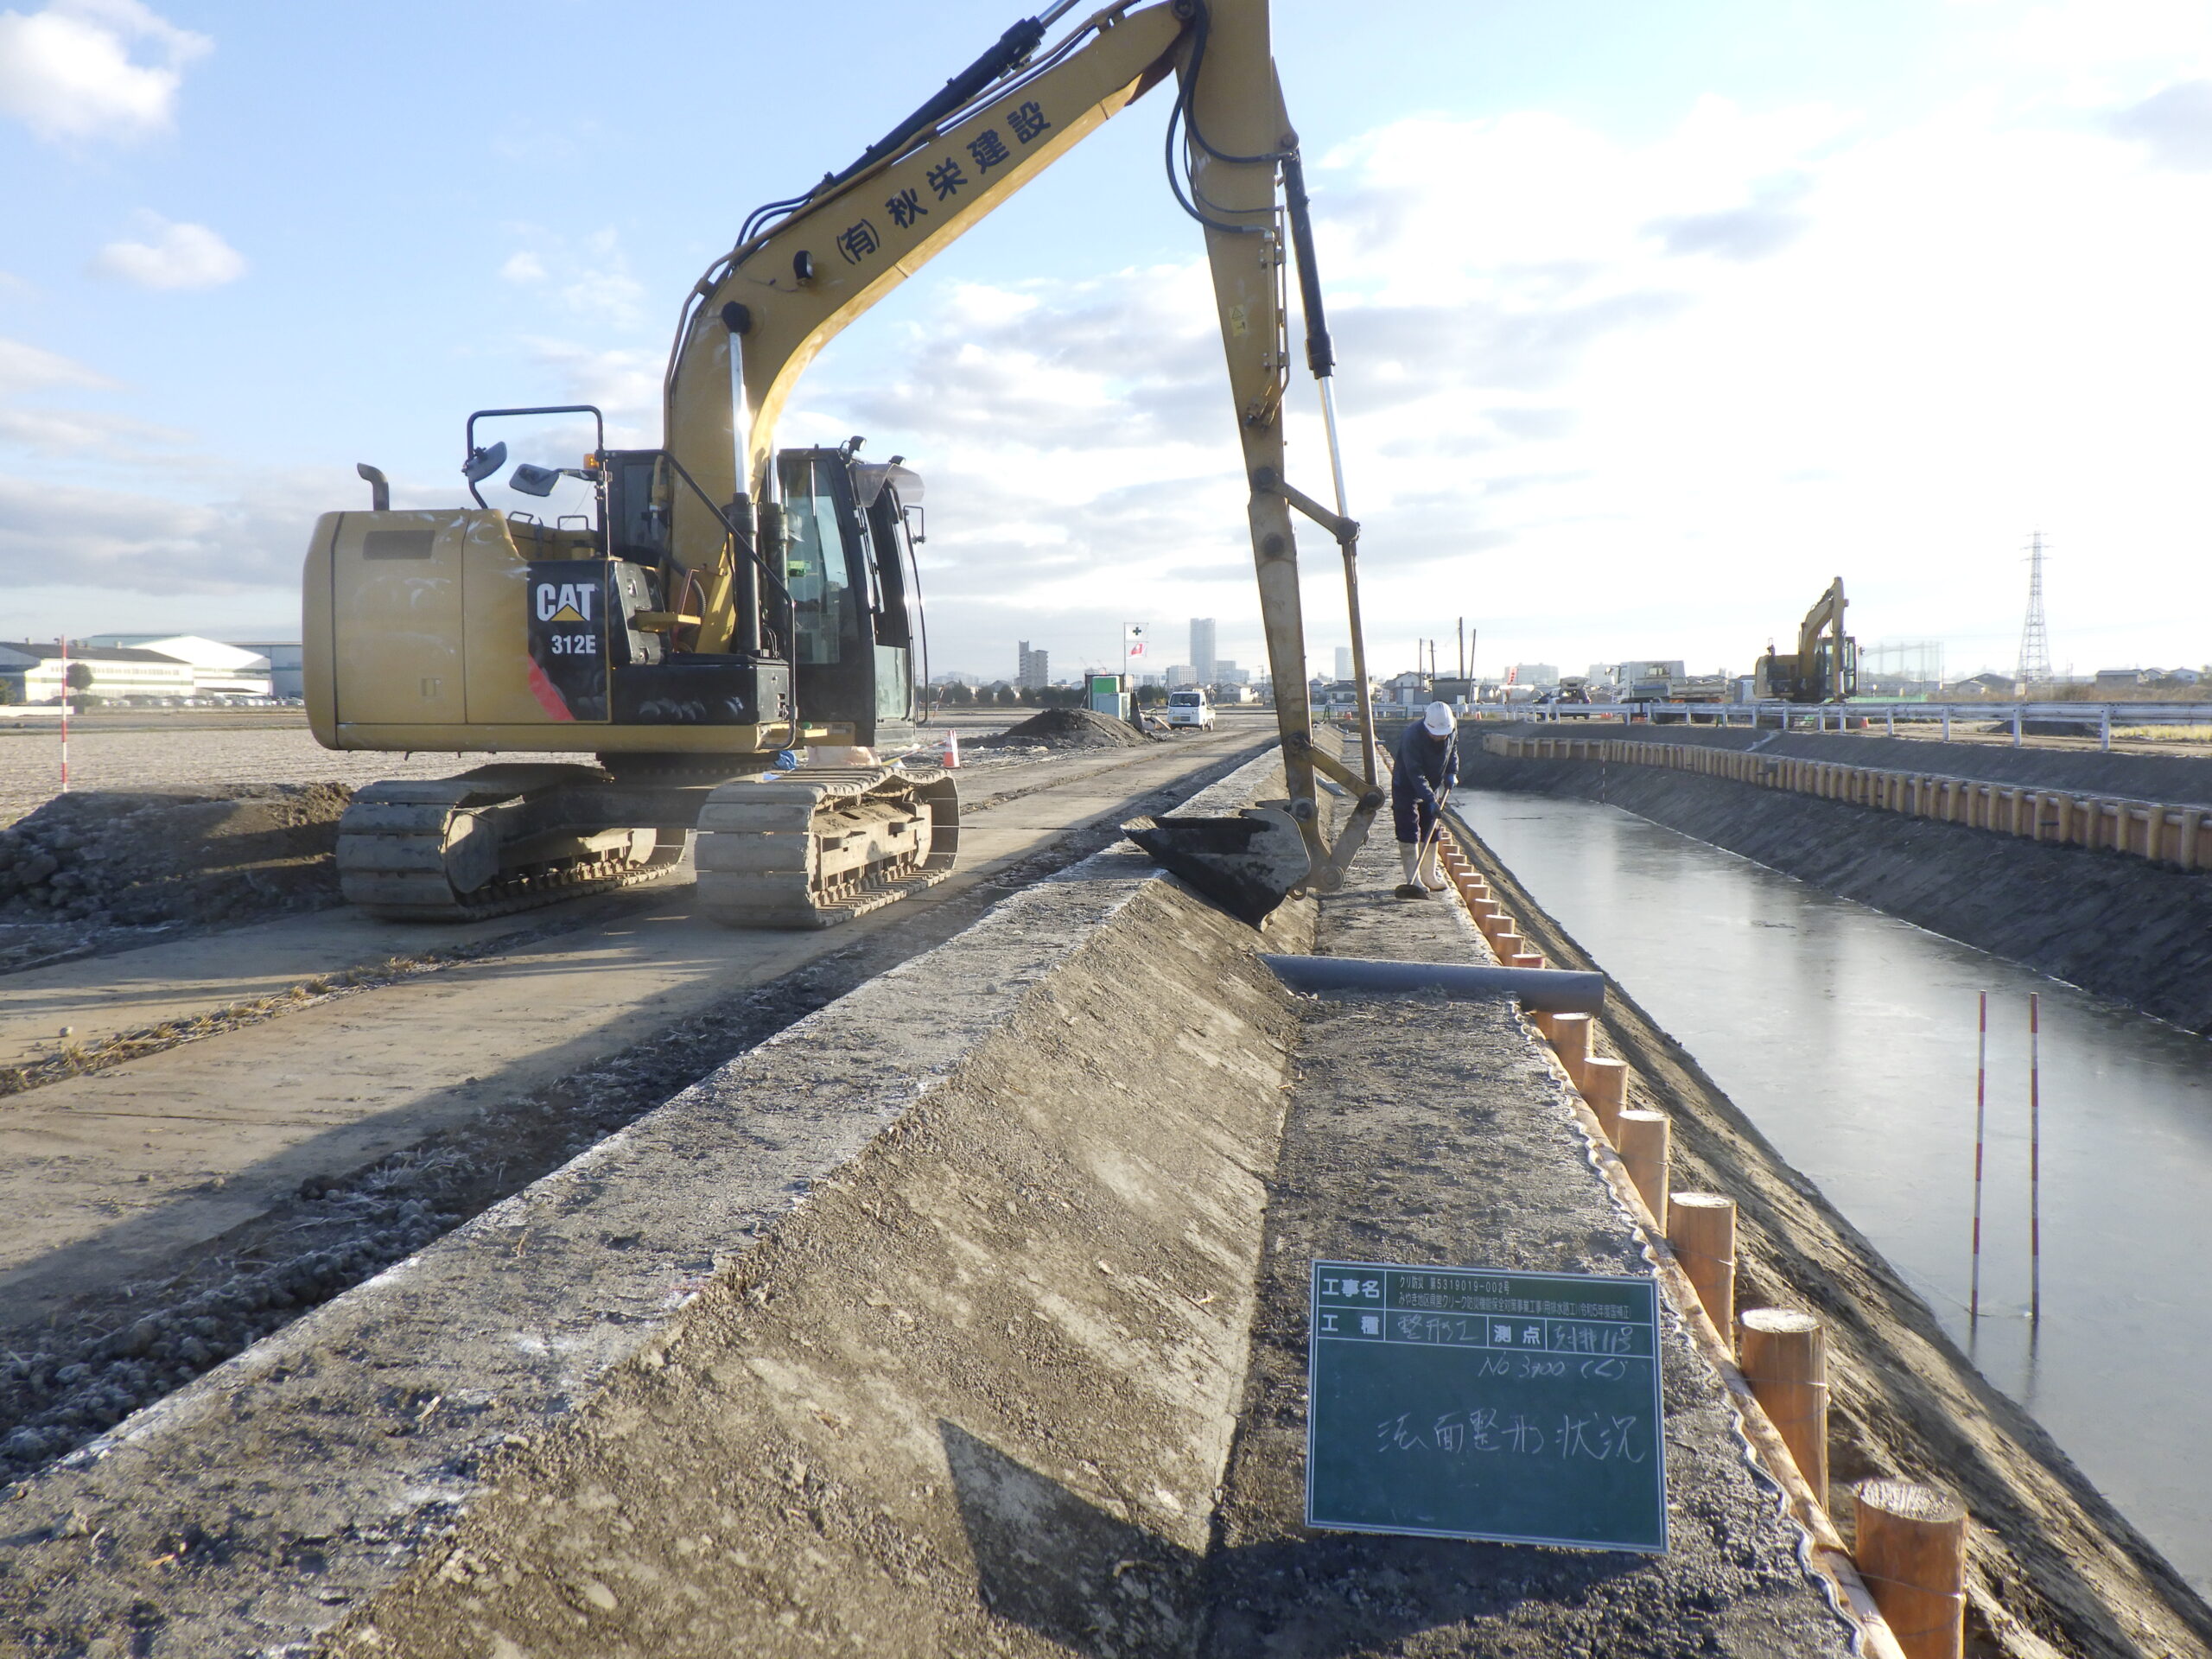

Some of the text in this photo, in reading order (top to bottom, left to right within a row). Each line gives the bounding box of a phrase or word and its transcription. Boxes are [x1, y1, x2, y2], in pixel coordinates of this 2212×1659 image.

[537, 583, 595, 621] CAT
[551, 635, 596, 654] 312E
[1321, 1277, 1381, 1299] 工事名
[1400, 1274, 1424, 1290] クリ防災
[1321, 1313, 1380, 1336] 工種
[1397, 1313, 1480, 1344] 整形工
[1493, 1324, 1541, 1345] 測点
[1377, 1408, 1646, 1465] 法面整形状況
